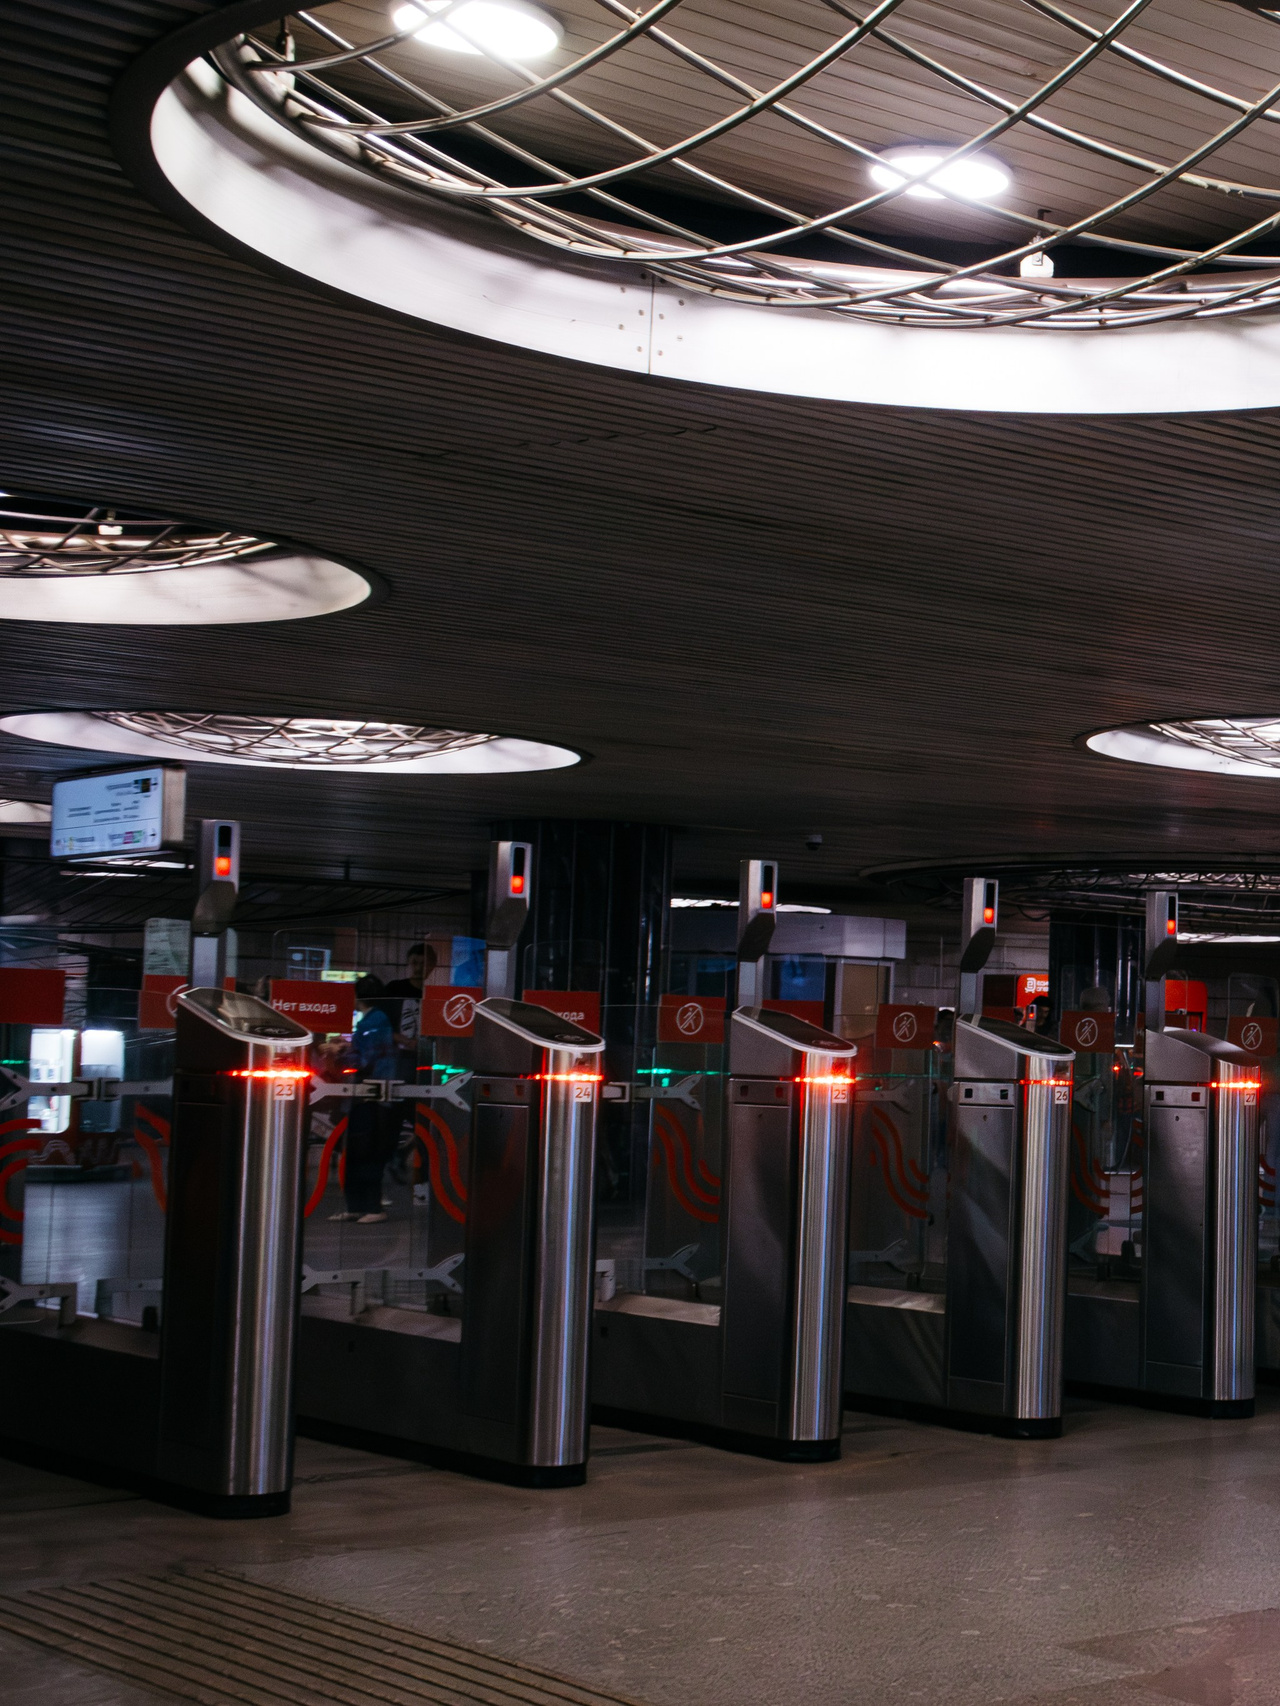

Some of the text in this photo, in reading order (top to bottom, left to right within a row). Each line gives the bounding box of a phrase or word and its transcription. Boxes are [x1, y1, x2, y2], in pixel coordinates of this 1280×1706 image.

[272, 999, 337, 1014] Нет входа
[556, 1011, 585, 1021] хода
[276, 1084, 293, 1096] 23
[575, 1087, 590, 1098] 24
[833, 1089, 846, 1100] 25
[1056, 1090, 1068, 1101] 26
[1246, 1093, 1255, 1102] 27
